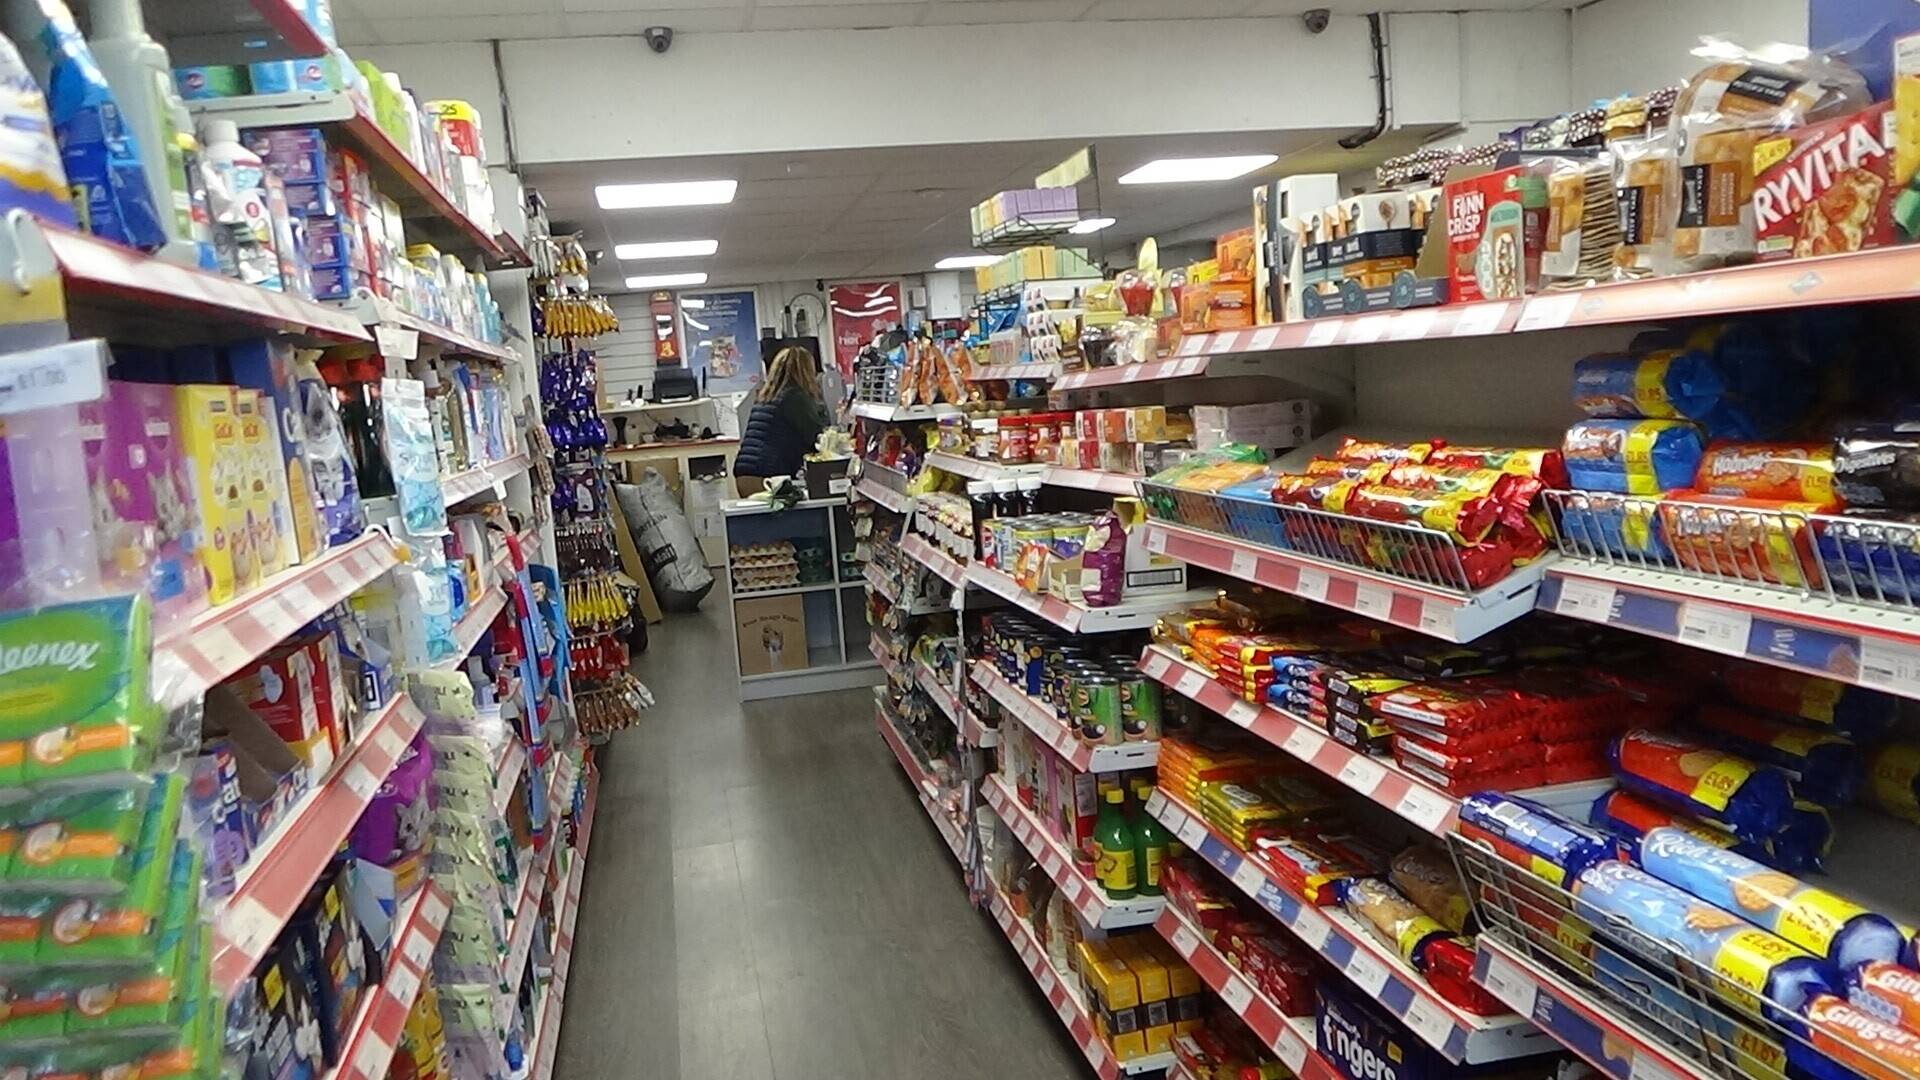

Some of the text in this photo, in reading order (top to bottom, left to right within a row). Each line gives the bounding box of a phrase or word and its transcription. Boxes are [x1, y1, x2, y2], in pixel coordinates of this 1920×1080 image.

[1753, 122, 1887, 232] RYVITA
[1453, 192, 1485, 219] FINN
[1447, 214, 1481, 237] CRISP
[1834, 452, 1897, 474] Digestives
[1322, 1014, 1396, 1080] fingers
